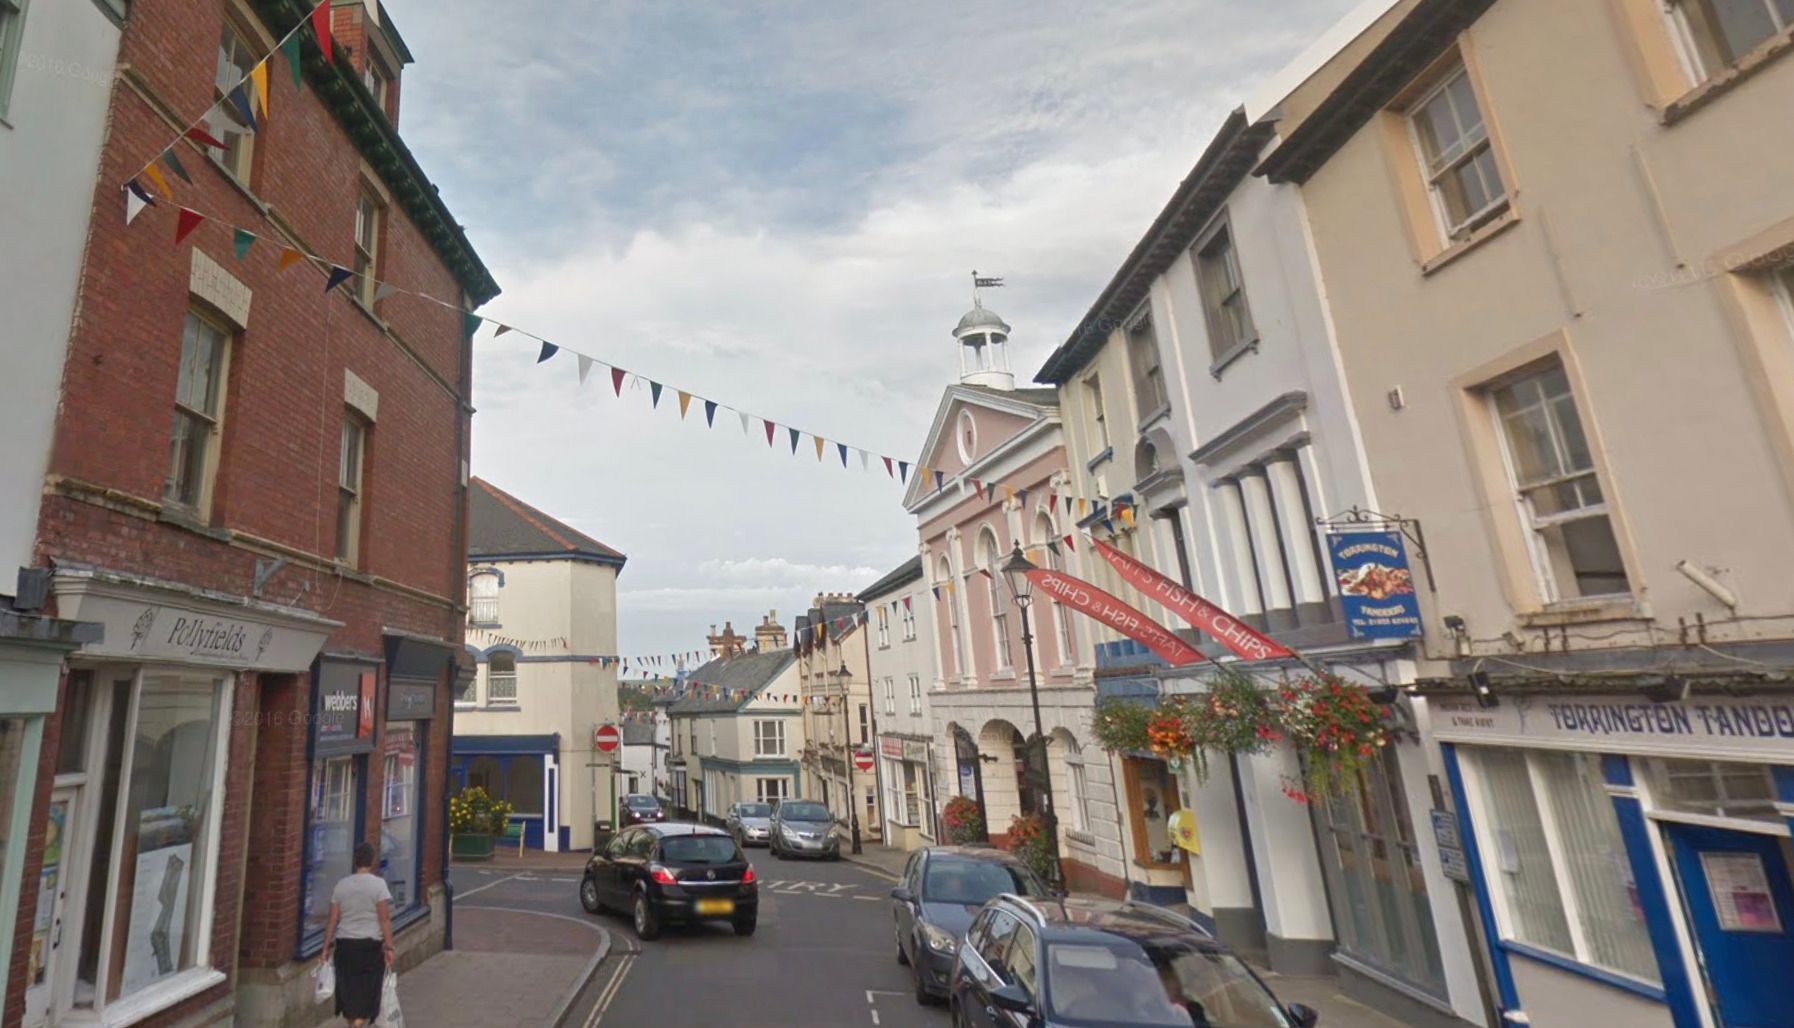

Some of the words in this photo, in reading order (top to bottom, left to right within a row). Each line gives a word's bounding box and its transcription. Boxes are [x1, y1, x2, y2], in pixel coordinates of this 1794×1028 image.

[1338, 544, 1398, 559] TORRINGTON
[1156, 581, 1198, 612] FISH
[1197, 608, 1209, 619] &
[1212, 615, 1272, 659] CHIPS
[168, 617, 246, 655] Pollyfields
[325, 690, 357, 711] webbers
[1548, 704, 1693, 735] TORRINGTON
